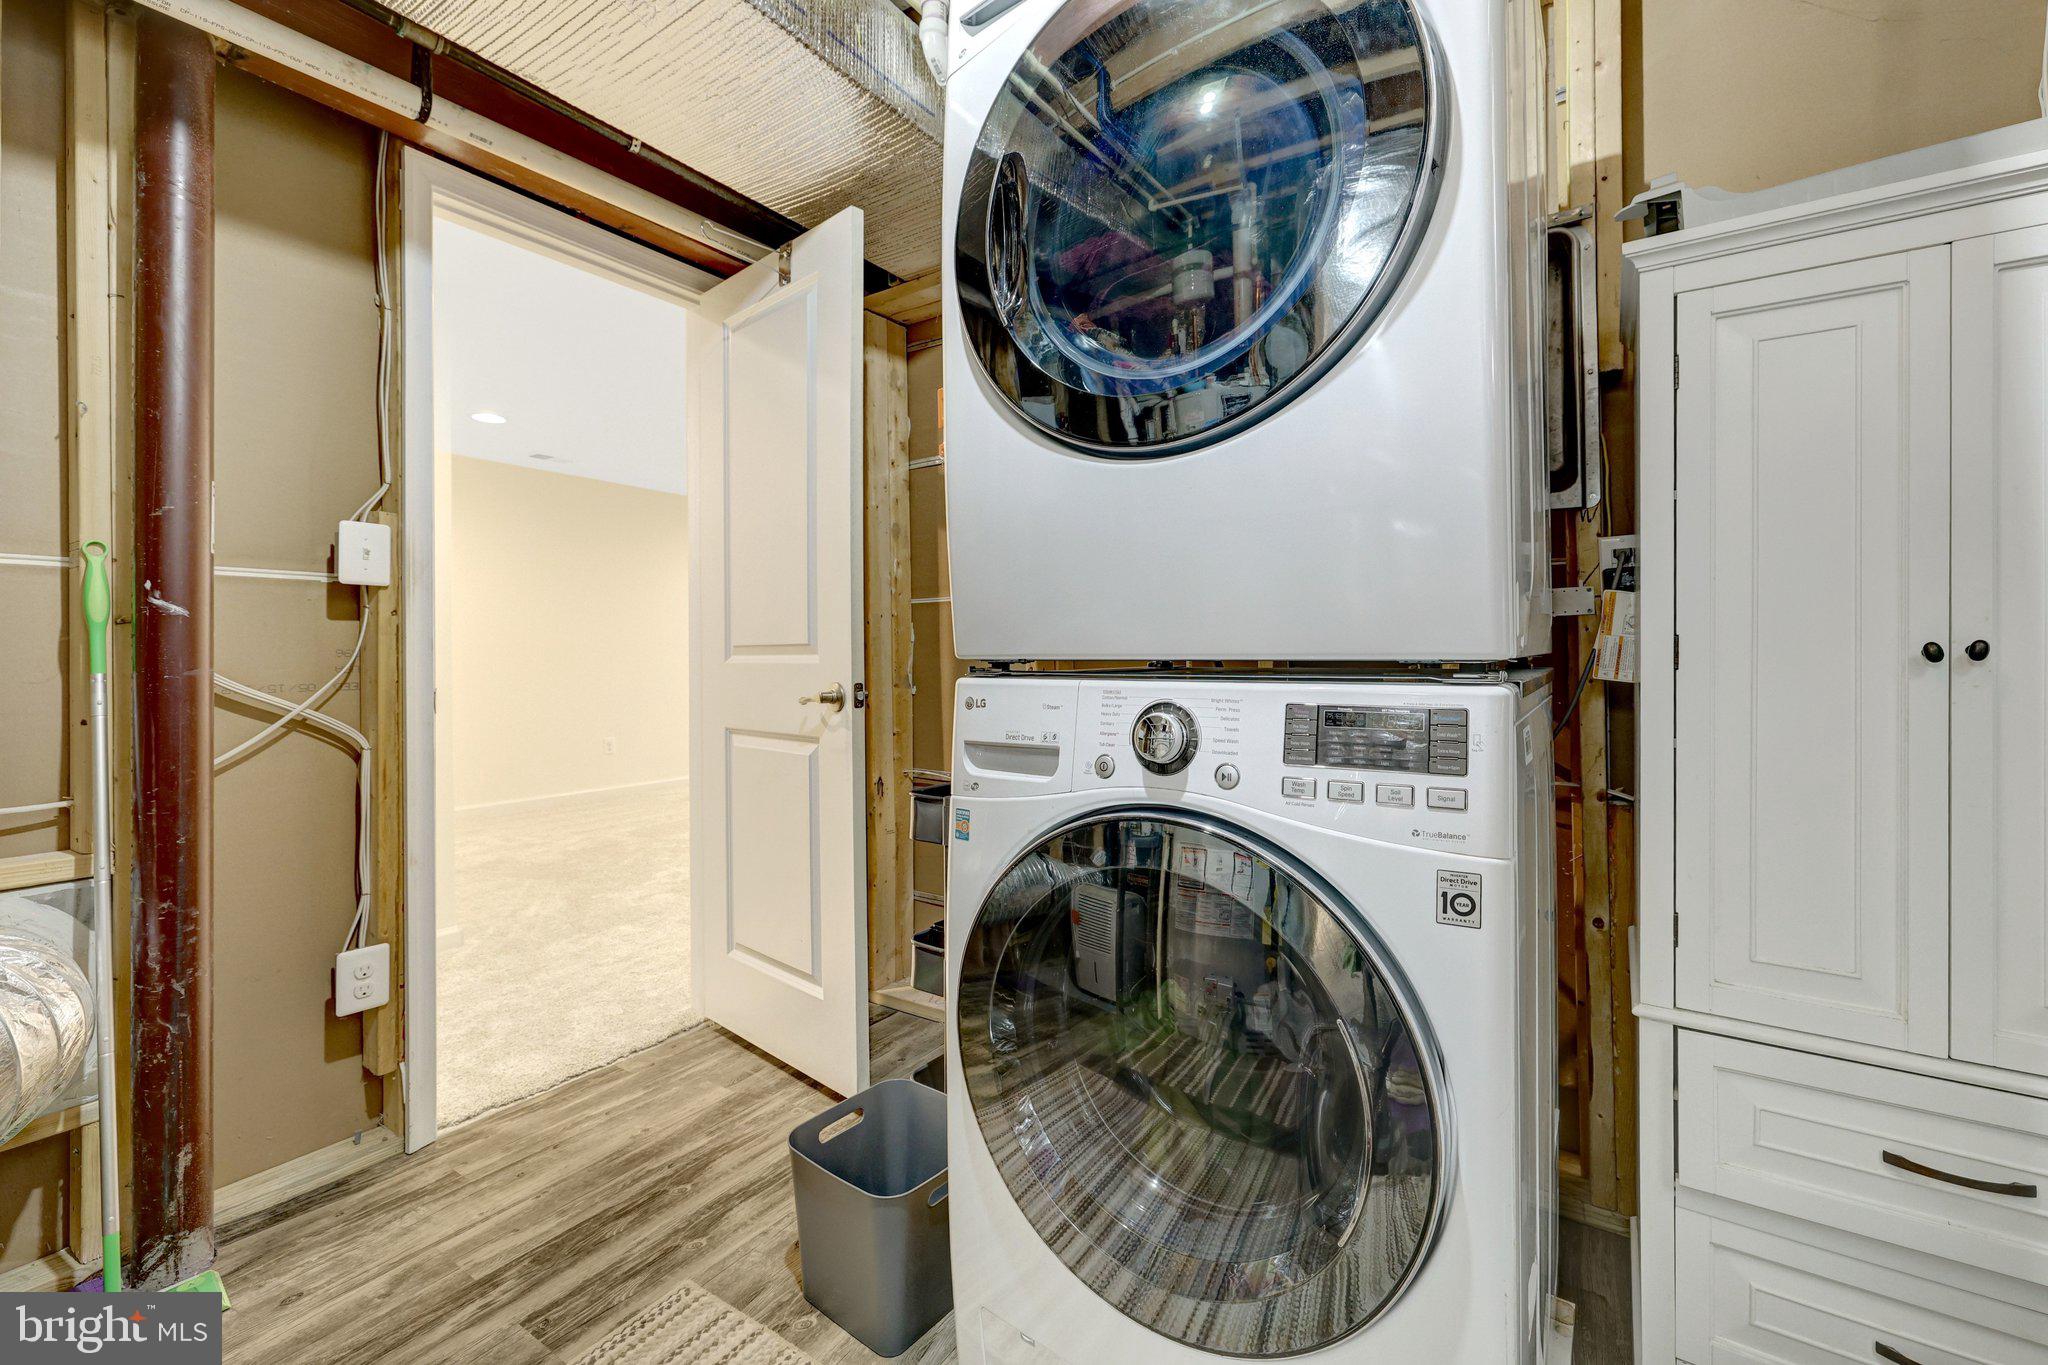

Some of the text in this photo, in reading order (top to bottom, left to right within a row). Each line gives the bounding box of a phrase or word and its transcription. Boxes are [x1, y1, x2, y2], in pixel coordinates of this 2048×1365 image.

[975, 698, 987, 708] LG
[1005, 733, 1035, 742] Direct Drive
[1340, 784, 1352, 793] Spin
[1337, 791, 1355, 799] Speed
[1437, 794, 1456, 803] Signal
[1440, 876, 1478, 886] Direct Drive
[1440, 891, 1477, 917] 10
